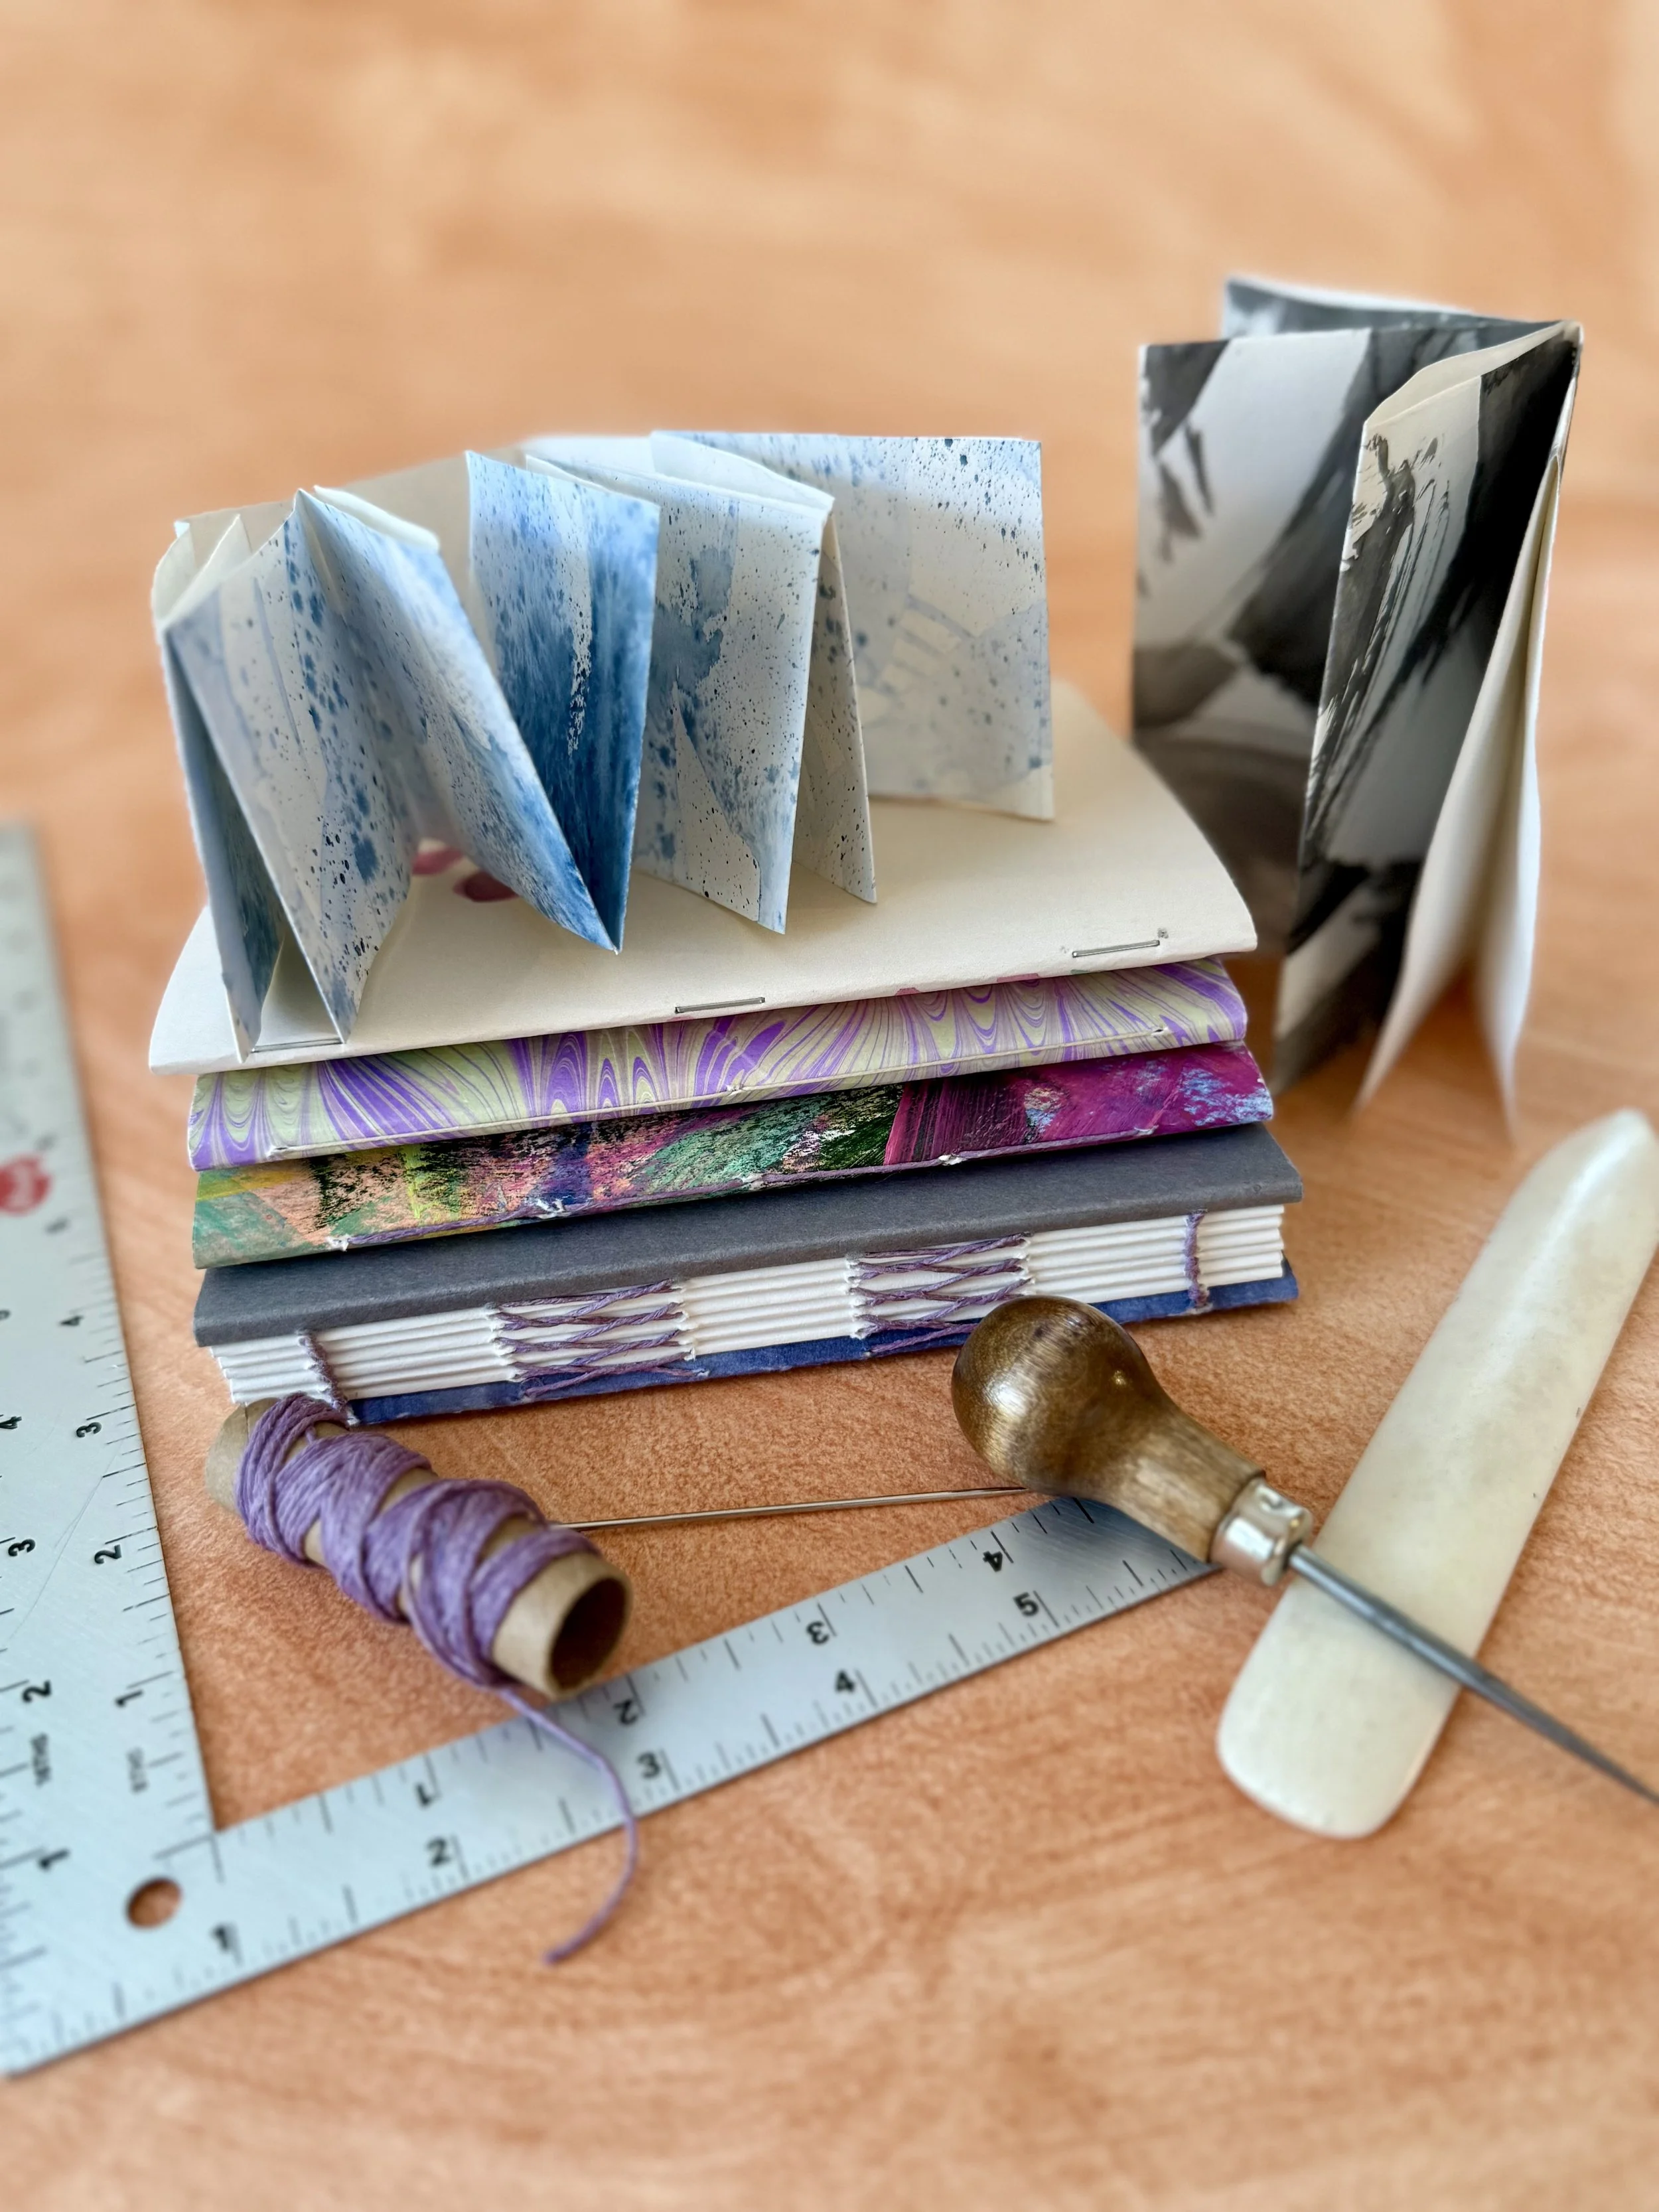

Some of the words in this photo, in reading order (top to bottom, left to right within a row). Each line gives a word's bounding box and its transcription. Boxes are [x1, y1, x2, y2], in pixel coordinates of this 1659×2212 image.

[76, 1422, 102, 1438] 3
[8, 1539, 36, 1556] 3
[94, 1544, 122, 1564] 2
[982, 1550, 1003, 1572] 4
[1013, 1591, 1039, 1617] 5
[806, 1621, 829, 1645] 3
[21, 1679, 52, 1704] 2
[834, 1669, 856, 1694] 4
[114, 1689, 143, 1708] 1
[613, 1699, 639, 1726] 2
[636, 1752, 662, 1779] 3
[414, 1781, 431, 1808] 1
[37, 1848, 70, 1872] 1
[425, 1836, 451, 1867] 2
[210, 1925, 230, 1952] 1
